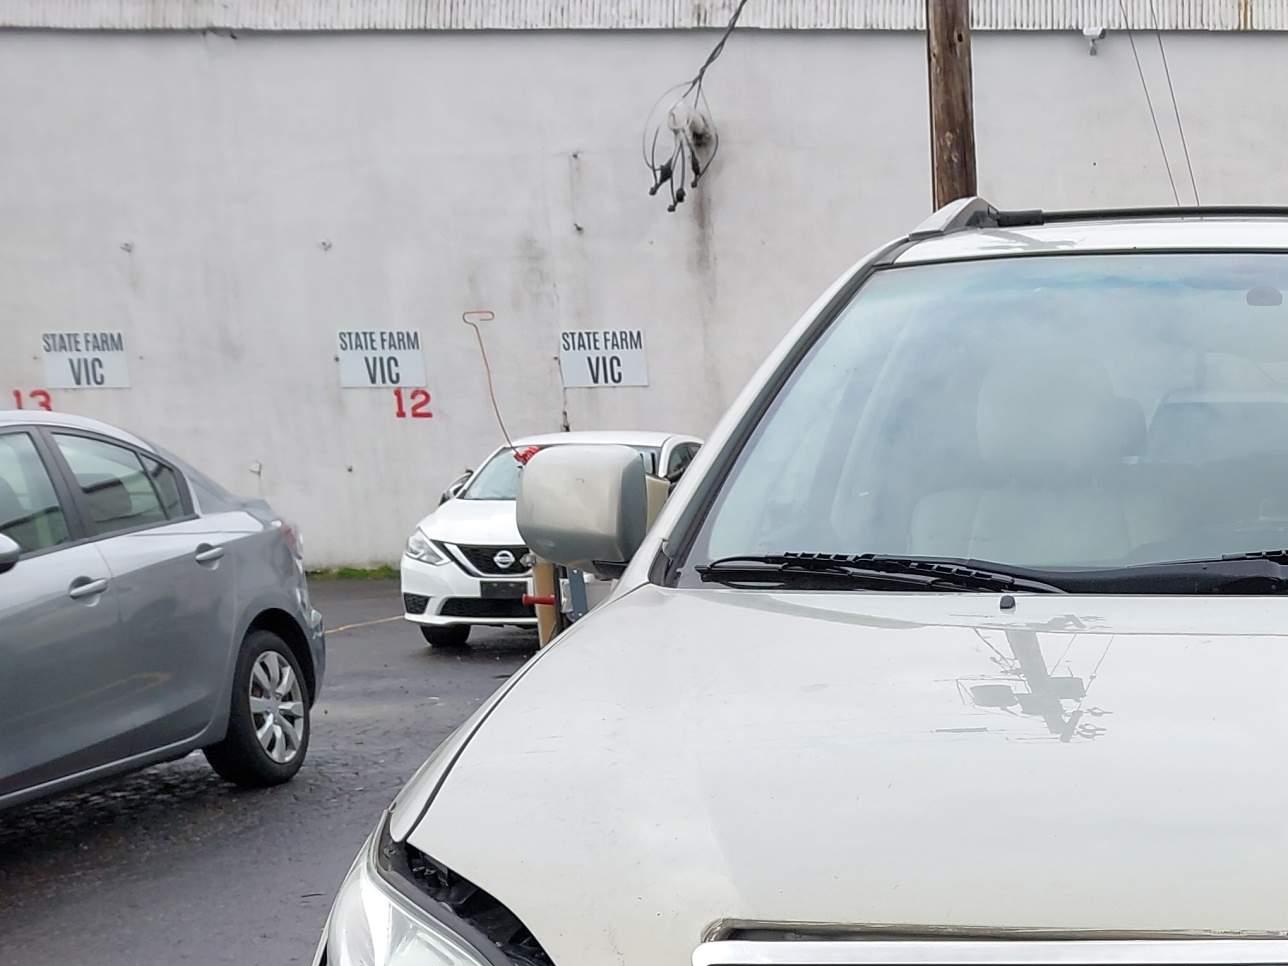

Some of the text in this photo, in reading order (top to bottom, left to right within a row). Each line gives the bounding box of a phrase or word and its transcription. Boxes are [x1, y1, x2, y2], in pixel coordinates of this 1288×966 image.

[42, 332, 124, 352] STATE FARM
[338, 331, 420, 351] STATE FARM
[562, 330, 643, 351] STATE FARM
[68, 357, 105, 386] VIC
[364, 356, 401, 385] VIC
[587, 356, 622, 384] VIC
[393, 387, 433, 418] 12
